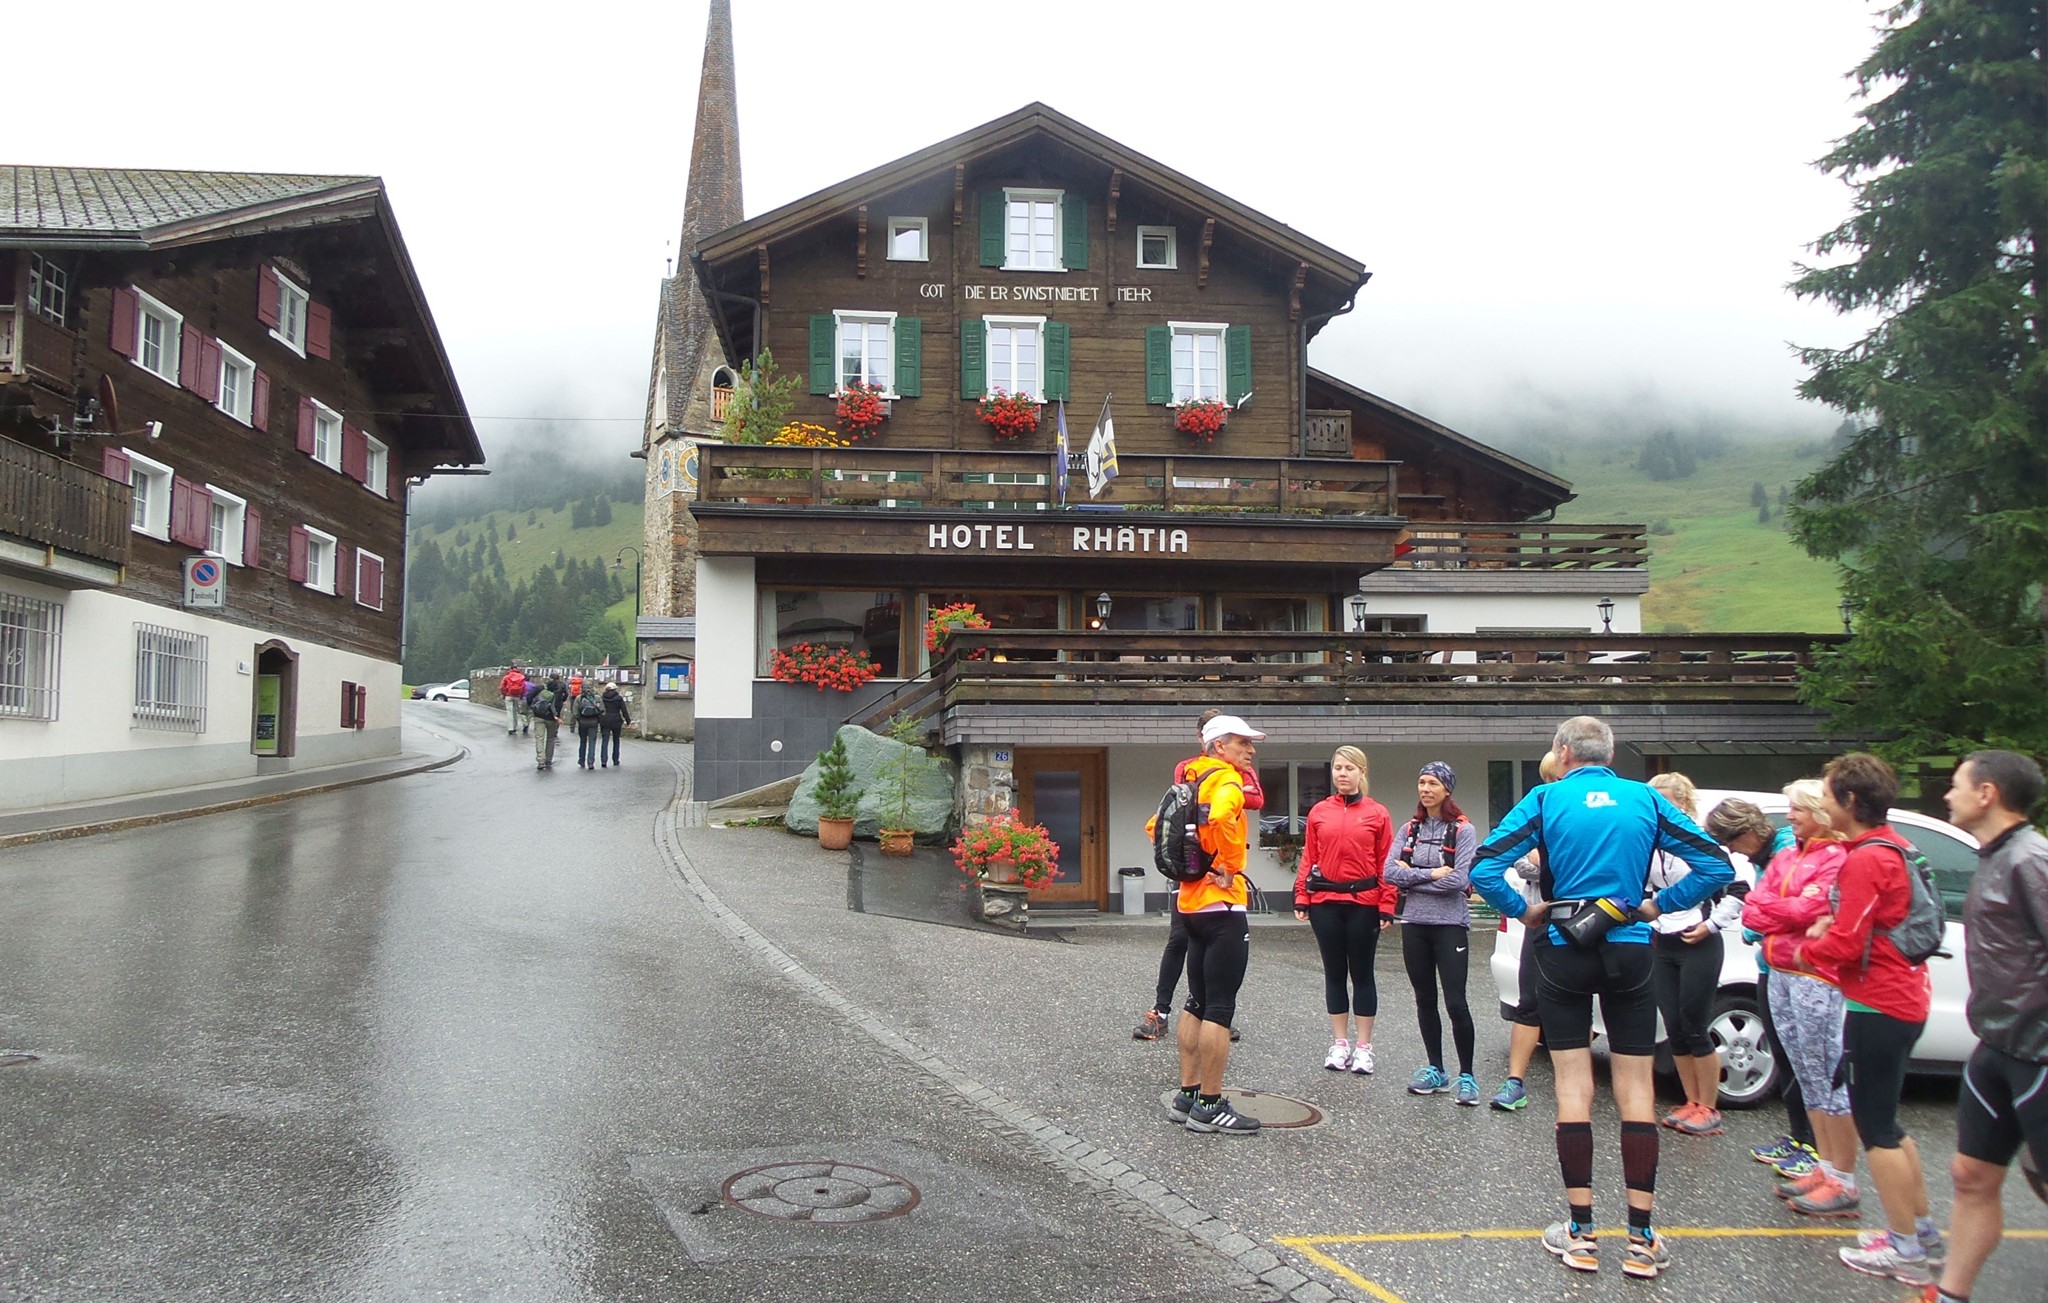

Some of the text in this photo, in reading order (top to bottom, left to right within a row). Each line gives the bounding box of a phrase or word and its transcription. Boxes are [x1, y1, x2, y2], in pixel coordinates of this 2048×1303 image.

[920, 283, 946, 298] GOT
[965, 285, 986, 299] DIE
[990, 286, 1008, 300] ER
[1117, 287, 1153, 302] MEHR
[929, 524, 1188, 552] HOTEL RHÄTIA
[7, 647, 24, 666] 63
[997, 752, 1008, 760] 26
